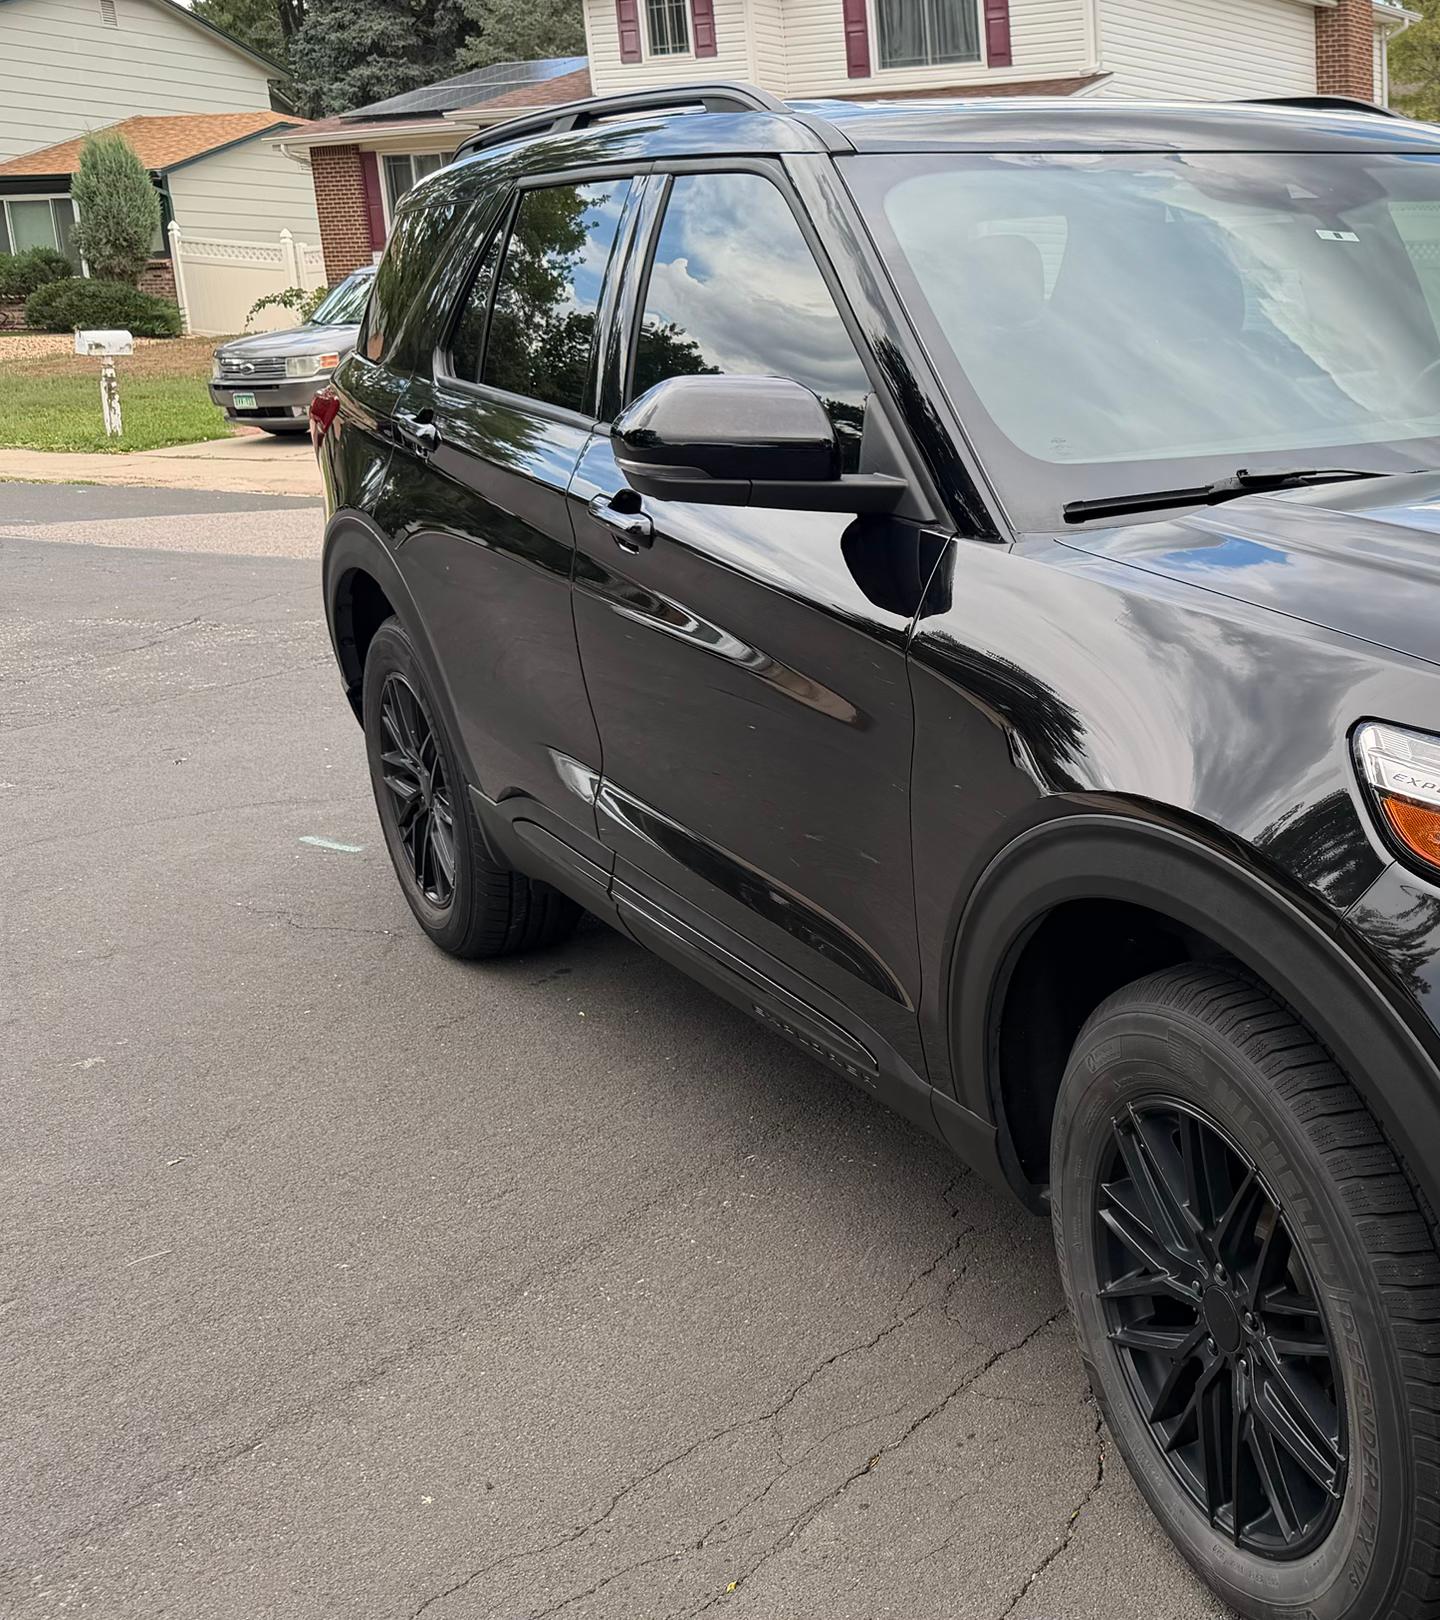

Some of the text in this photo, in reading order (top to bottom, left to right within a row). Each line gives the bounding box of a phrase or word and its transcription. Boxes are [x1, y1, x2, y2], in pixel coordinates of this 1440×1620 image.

[1214, 1077, 1336, 1274] MICHELIN
[1341, 1308, 1380, 1491] DEFENDER
[1356, 1496, 1379, 1557] LTX
